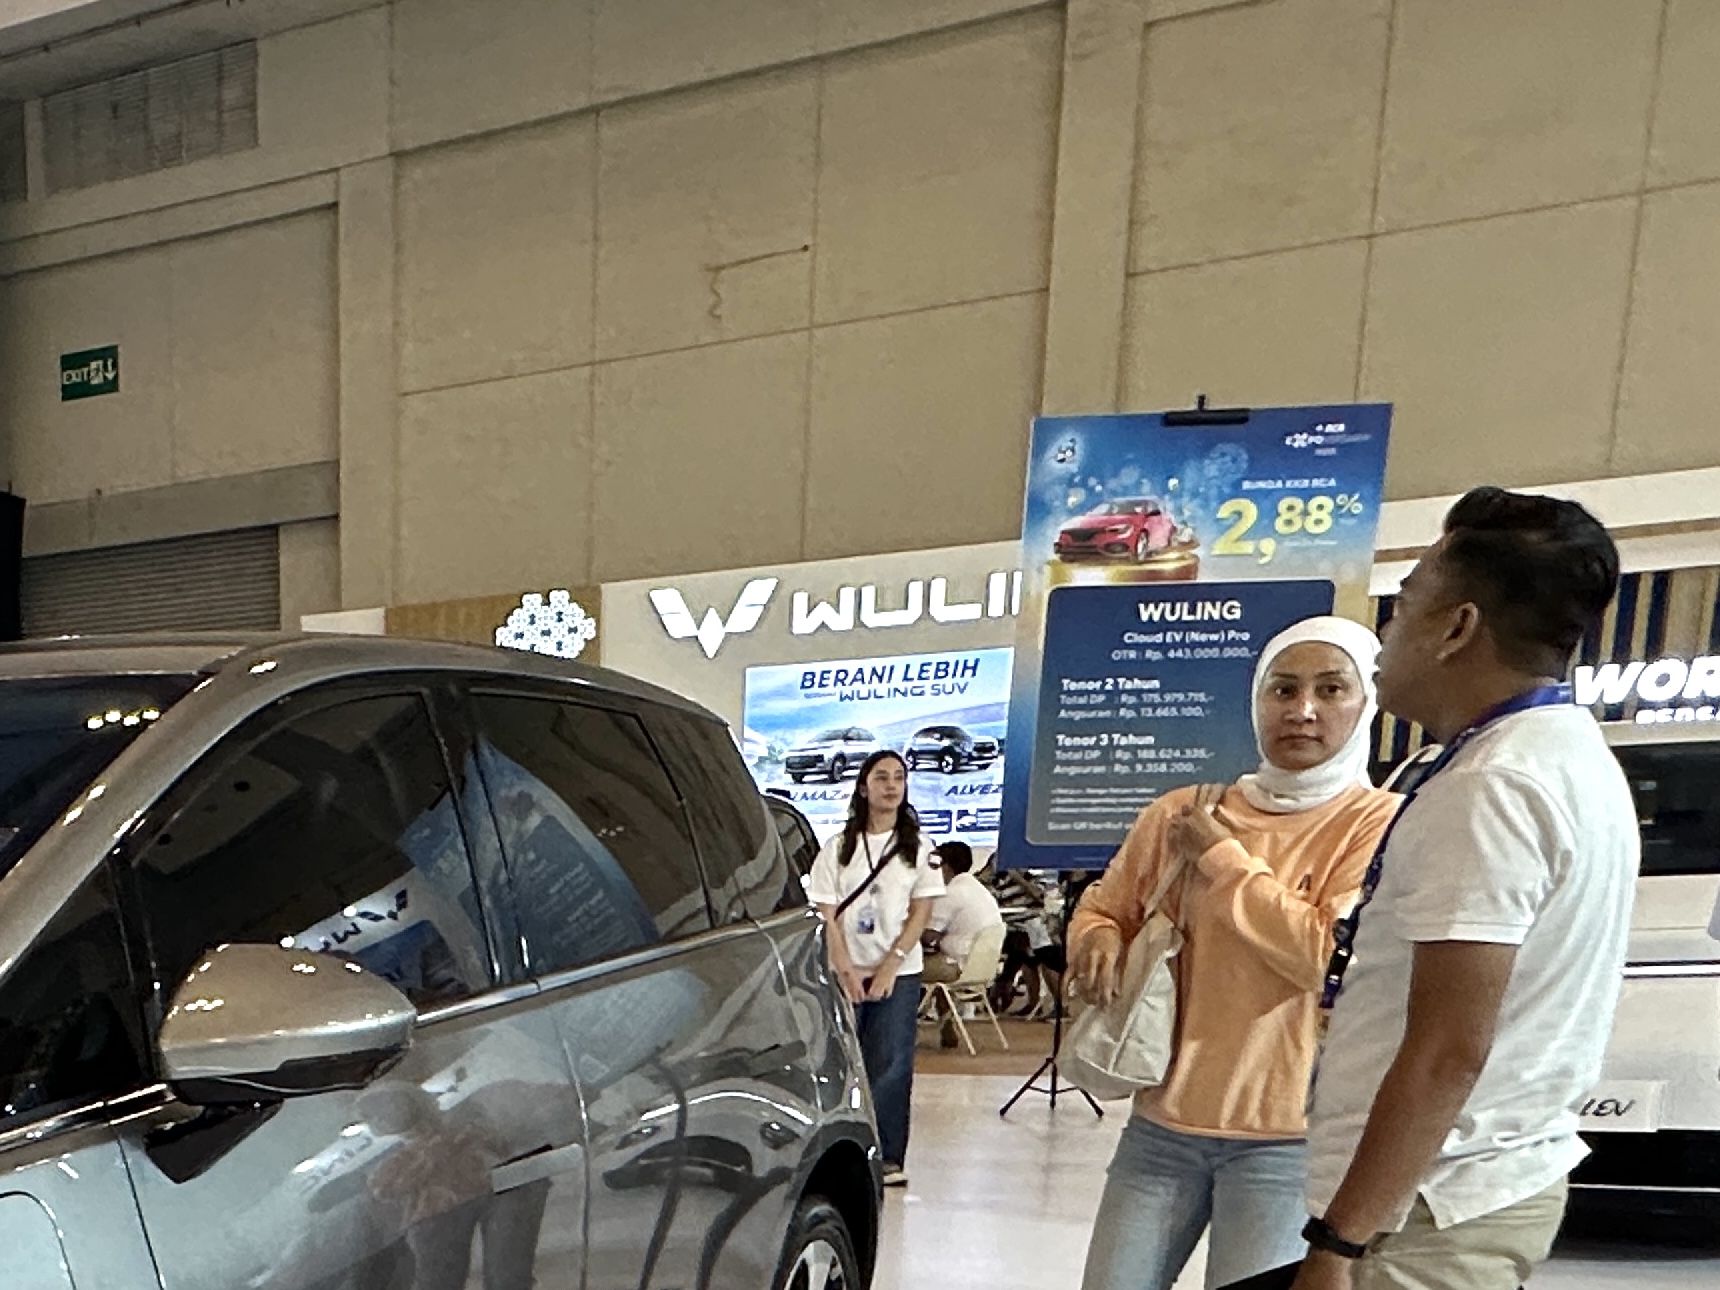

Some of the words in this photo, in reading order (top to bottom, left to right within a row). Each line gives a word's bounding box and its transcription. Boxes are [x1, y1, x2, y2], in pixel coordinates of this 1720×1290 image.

[1211, 492, 1363, 564] 2,88%
[1138, 601, 1242, 622] WULING
[1123, 632, 1163, 644] Cloud
[1165, 631, 1184, 643] EV
[1185, 630, 1225, 643] (New)
[1227, 630, 1250, 641] Pro
[800, 664, 895, 690] BERANI
[902, 658, 980, 682] LEBIH
[1061, 678, 1102, 691] Tenor
[1104, 678, 1114, 690] 2
[1116, 677, 1160, 690] Tahun
[839, 685, 925, 702] WULING
[931, 682, 969, 696] SUV
[1056, 734, 1097, 747] Tenor
[1099, 733, 1109, 746] 3
[1111, 733, 1155, 746] Tahun
